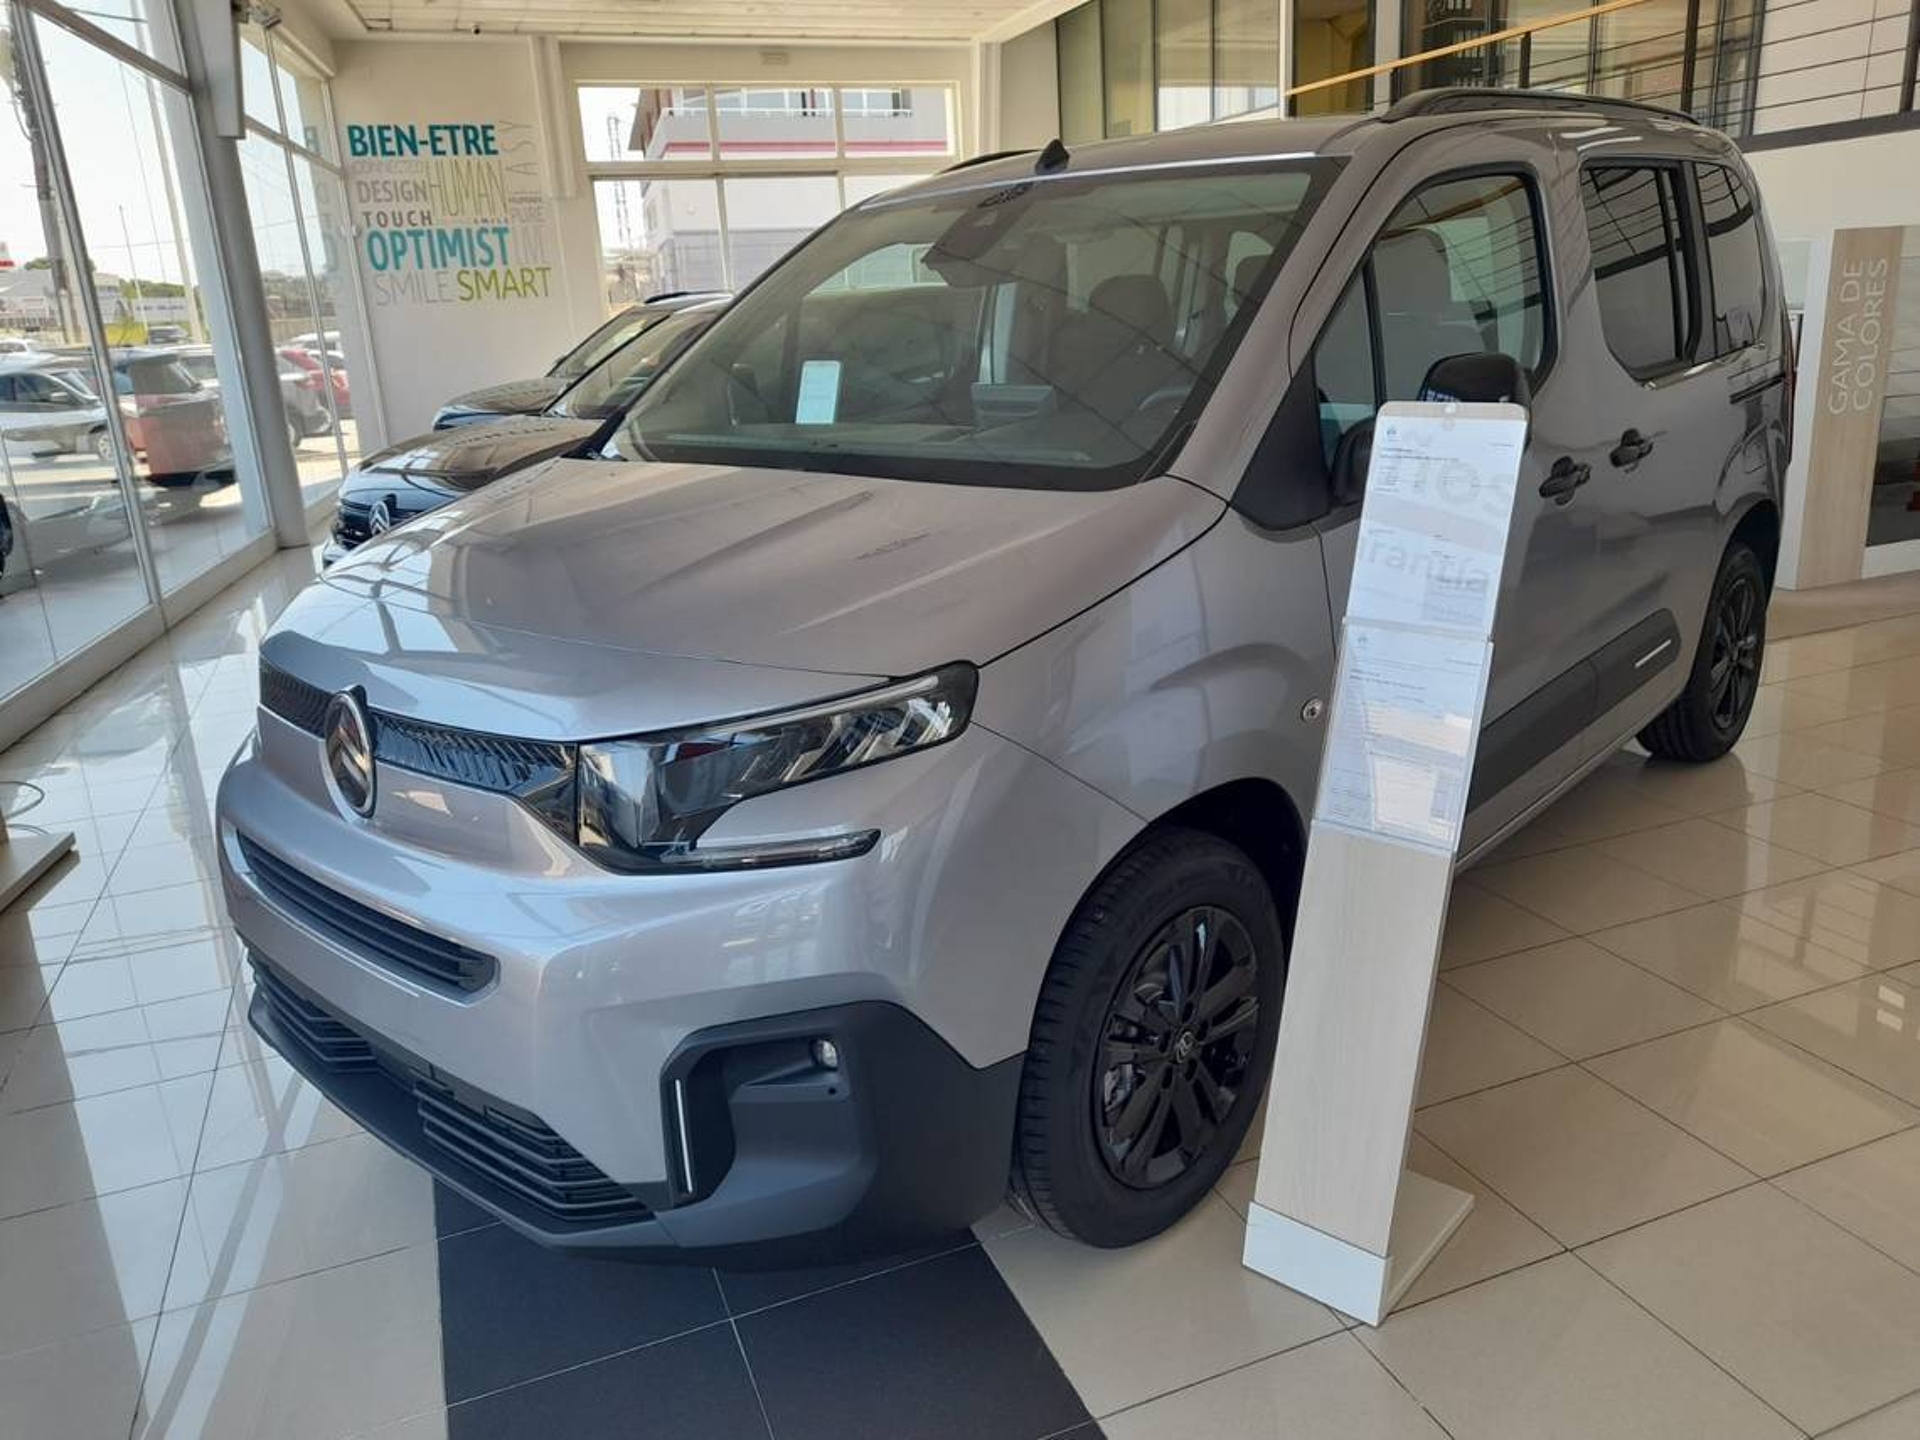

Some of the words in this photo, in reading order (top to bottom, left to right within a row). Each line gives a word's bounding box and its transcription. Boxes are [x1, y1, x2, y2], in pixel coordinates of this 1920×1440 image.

[347, 124, 499, 157] BIEN-ETRE
[357, 180, 428, 204] DESIGN
[428, 159, 508, 217] HUMAN
[364, 210, 433, 228] TOUCH
[367, 226, 510, 272] OPTIMIST
[375, 270, 455, 306] SMILE
[456, 267, 552, 302] SMART
[1840, 259, 1863, 304] DE
[1853, 257, 1888, 412] COLORES
[1828, 314, 1858, 415] GAMA
